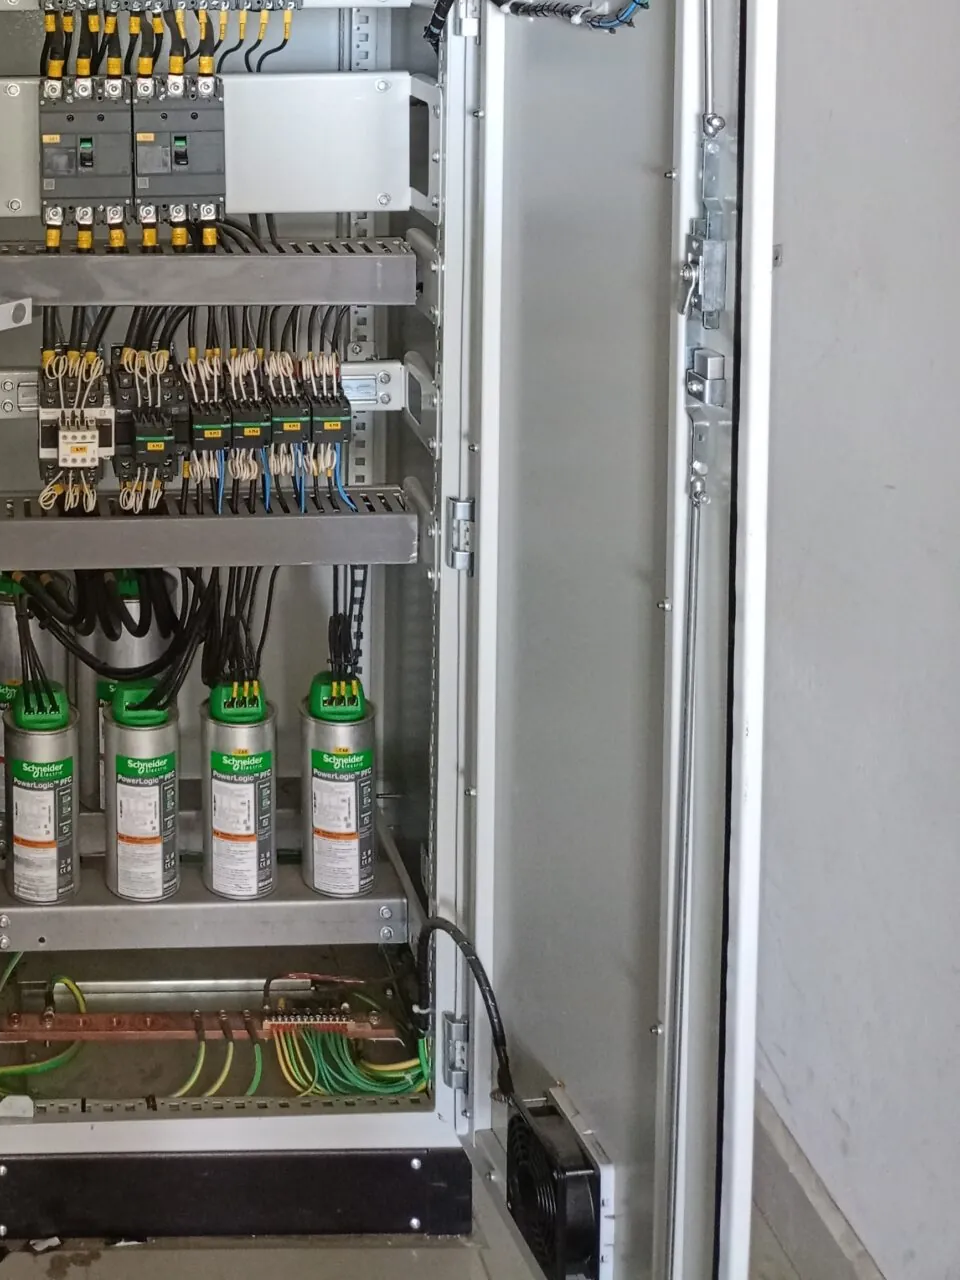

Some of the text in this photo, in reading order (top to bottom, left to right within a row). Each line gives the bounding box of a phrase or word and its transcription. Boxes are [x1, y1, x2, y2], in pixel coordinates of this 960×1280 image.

[127, 758, 168, 774] Schneider
[222, 755, 263, 770] Schneider
[323, 754, 364, 769] Schneider
[23, 763, 63, 778] Schneider
[164, 770, 175, 781] PFC
[260, 769, 271, 779] PFC
[361, 767, 372, 777] PFC
[60, 775, 72, 786] PFC
